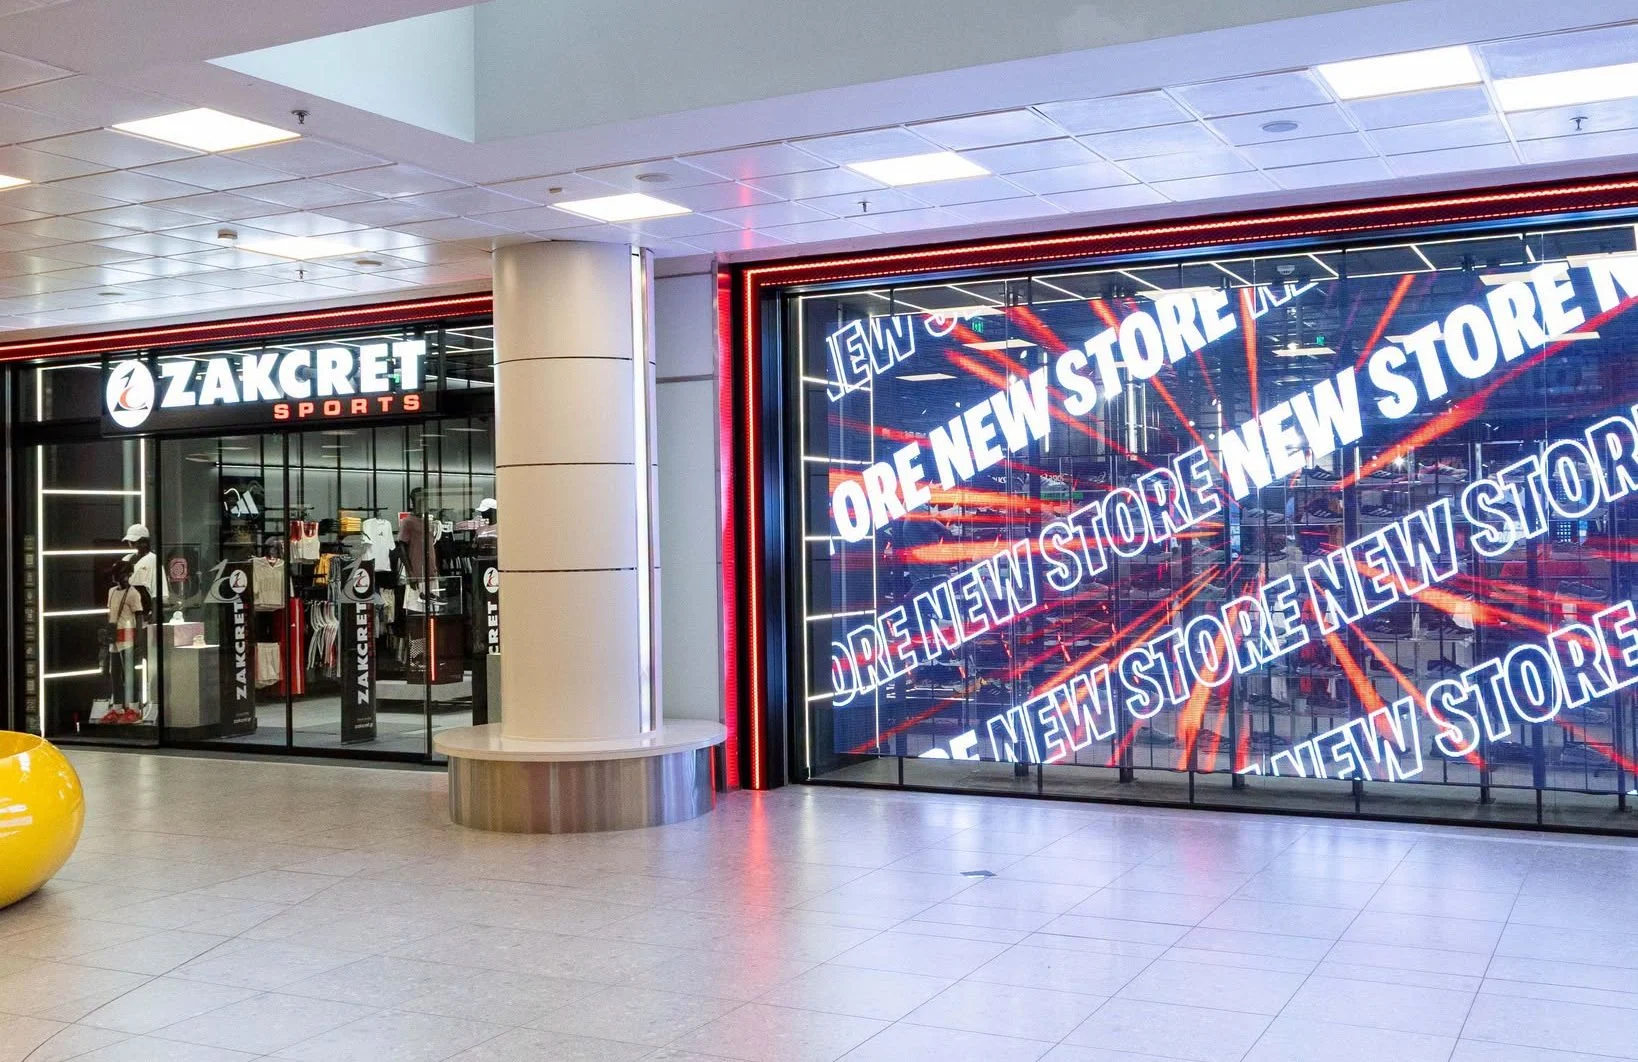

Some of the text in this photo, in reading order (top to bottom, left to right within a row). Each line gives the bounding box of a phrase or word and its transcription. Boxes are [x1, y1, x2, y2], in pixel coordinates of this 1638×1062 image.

[160, 340, 426, 408] ZAKCRET
[273, 394, 421, 420] SPORTS
[830, 289, 1237, 554] ORE NEW STORE
[913, 540, 1037, 660] NEW
[1039, 444, 1222, 592] STORE
[1221, 366, 1363, 500] NEW
[1368, 263, 1586, 419] STORE
[987, 403, 1638, 764] NEW STORE NEW STOR
[232, 602, 247, 700] ZAKCRET
[356, 602, 369, 705] ZAKCRET
[1426, 599, 1638, 758] STORE
